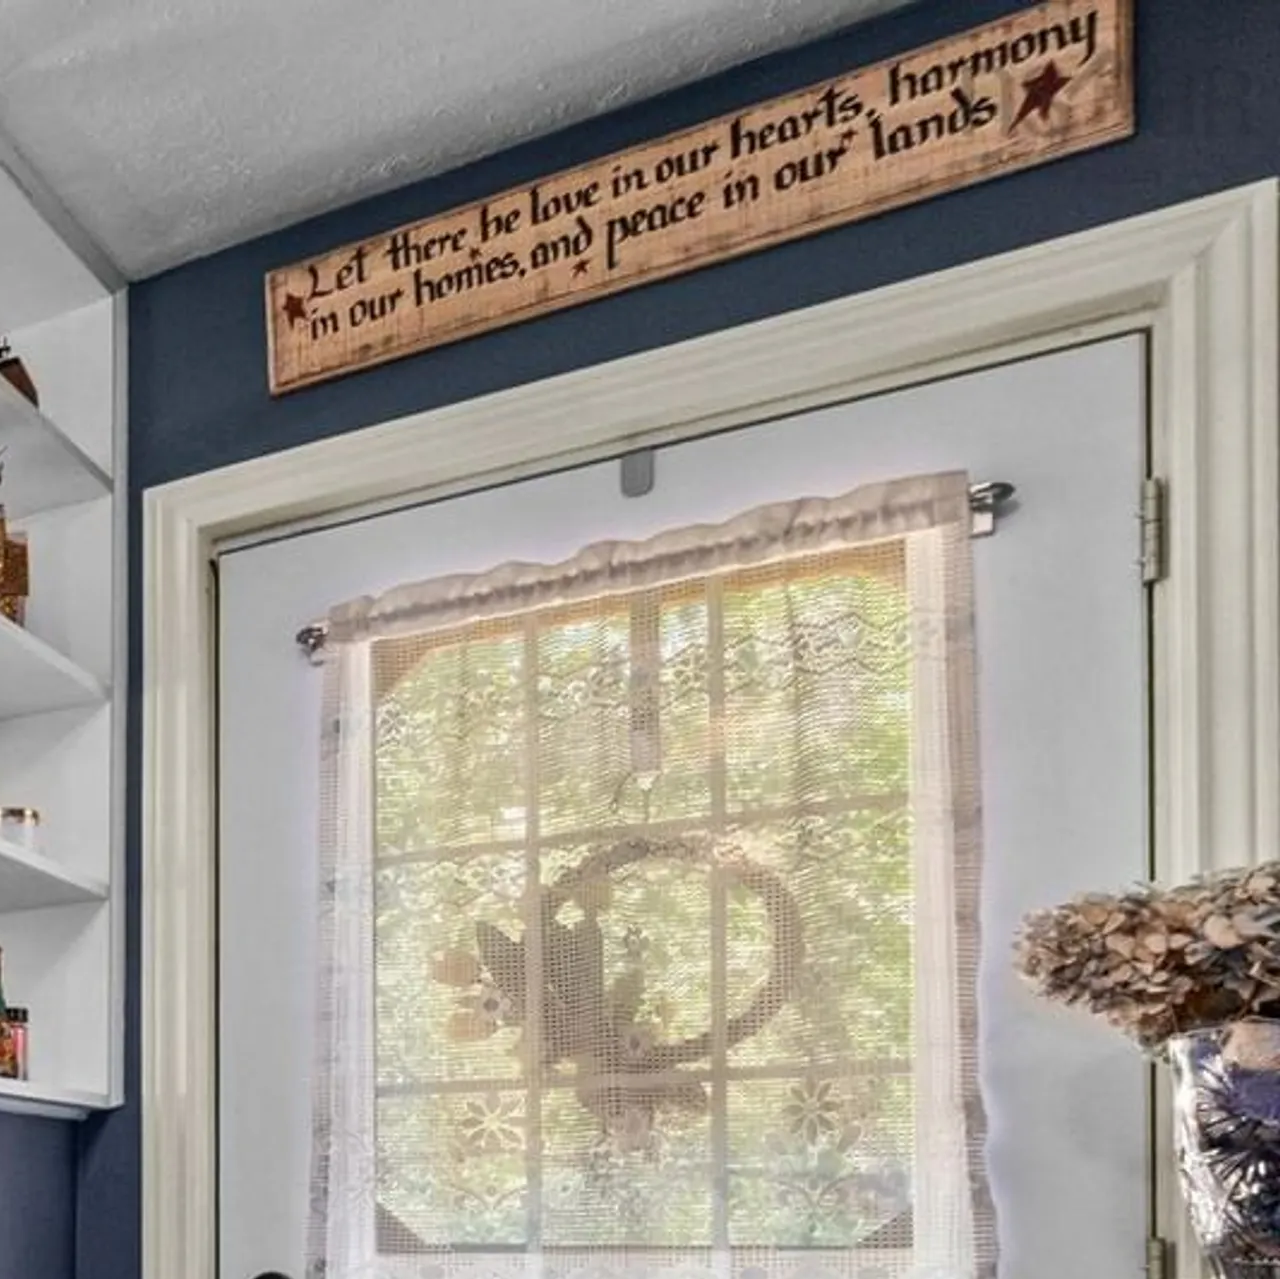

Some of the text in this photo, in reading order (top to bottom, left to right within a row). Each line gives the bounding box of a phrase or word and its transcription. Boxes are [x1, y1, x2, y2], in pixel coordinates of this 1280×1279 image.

[307, 10, 1099, 299] Let there be love in our hearts, harmony
[310, 87, 998, 340] in our homes, and peace in our lands
